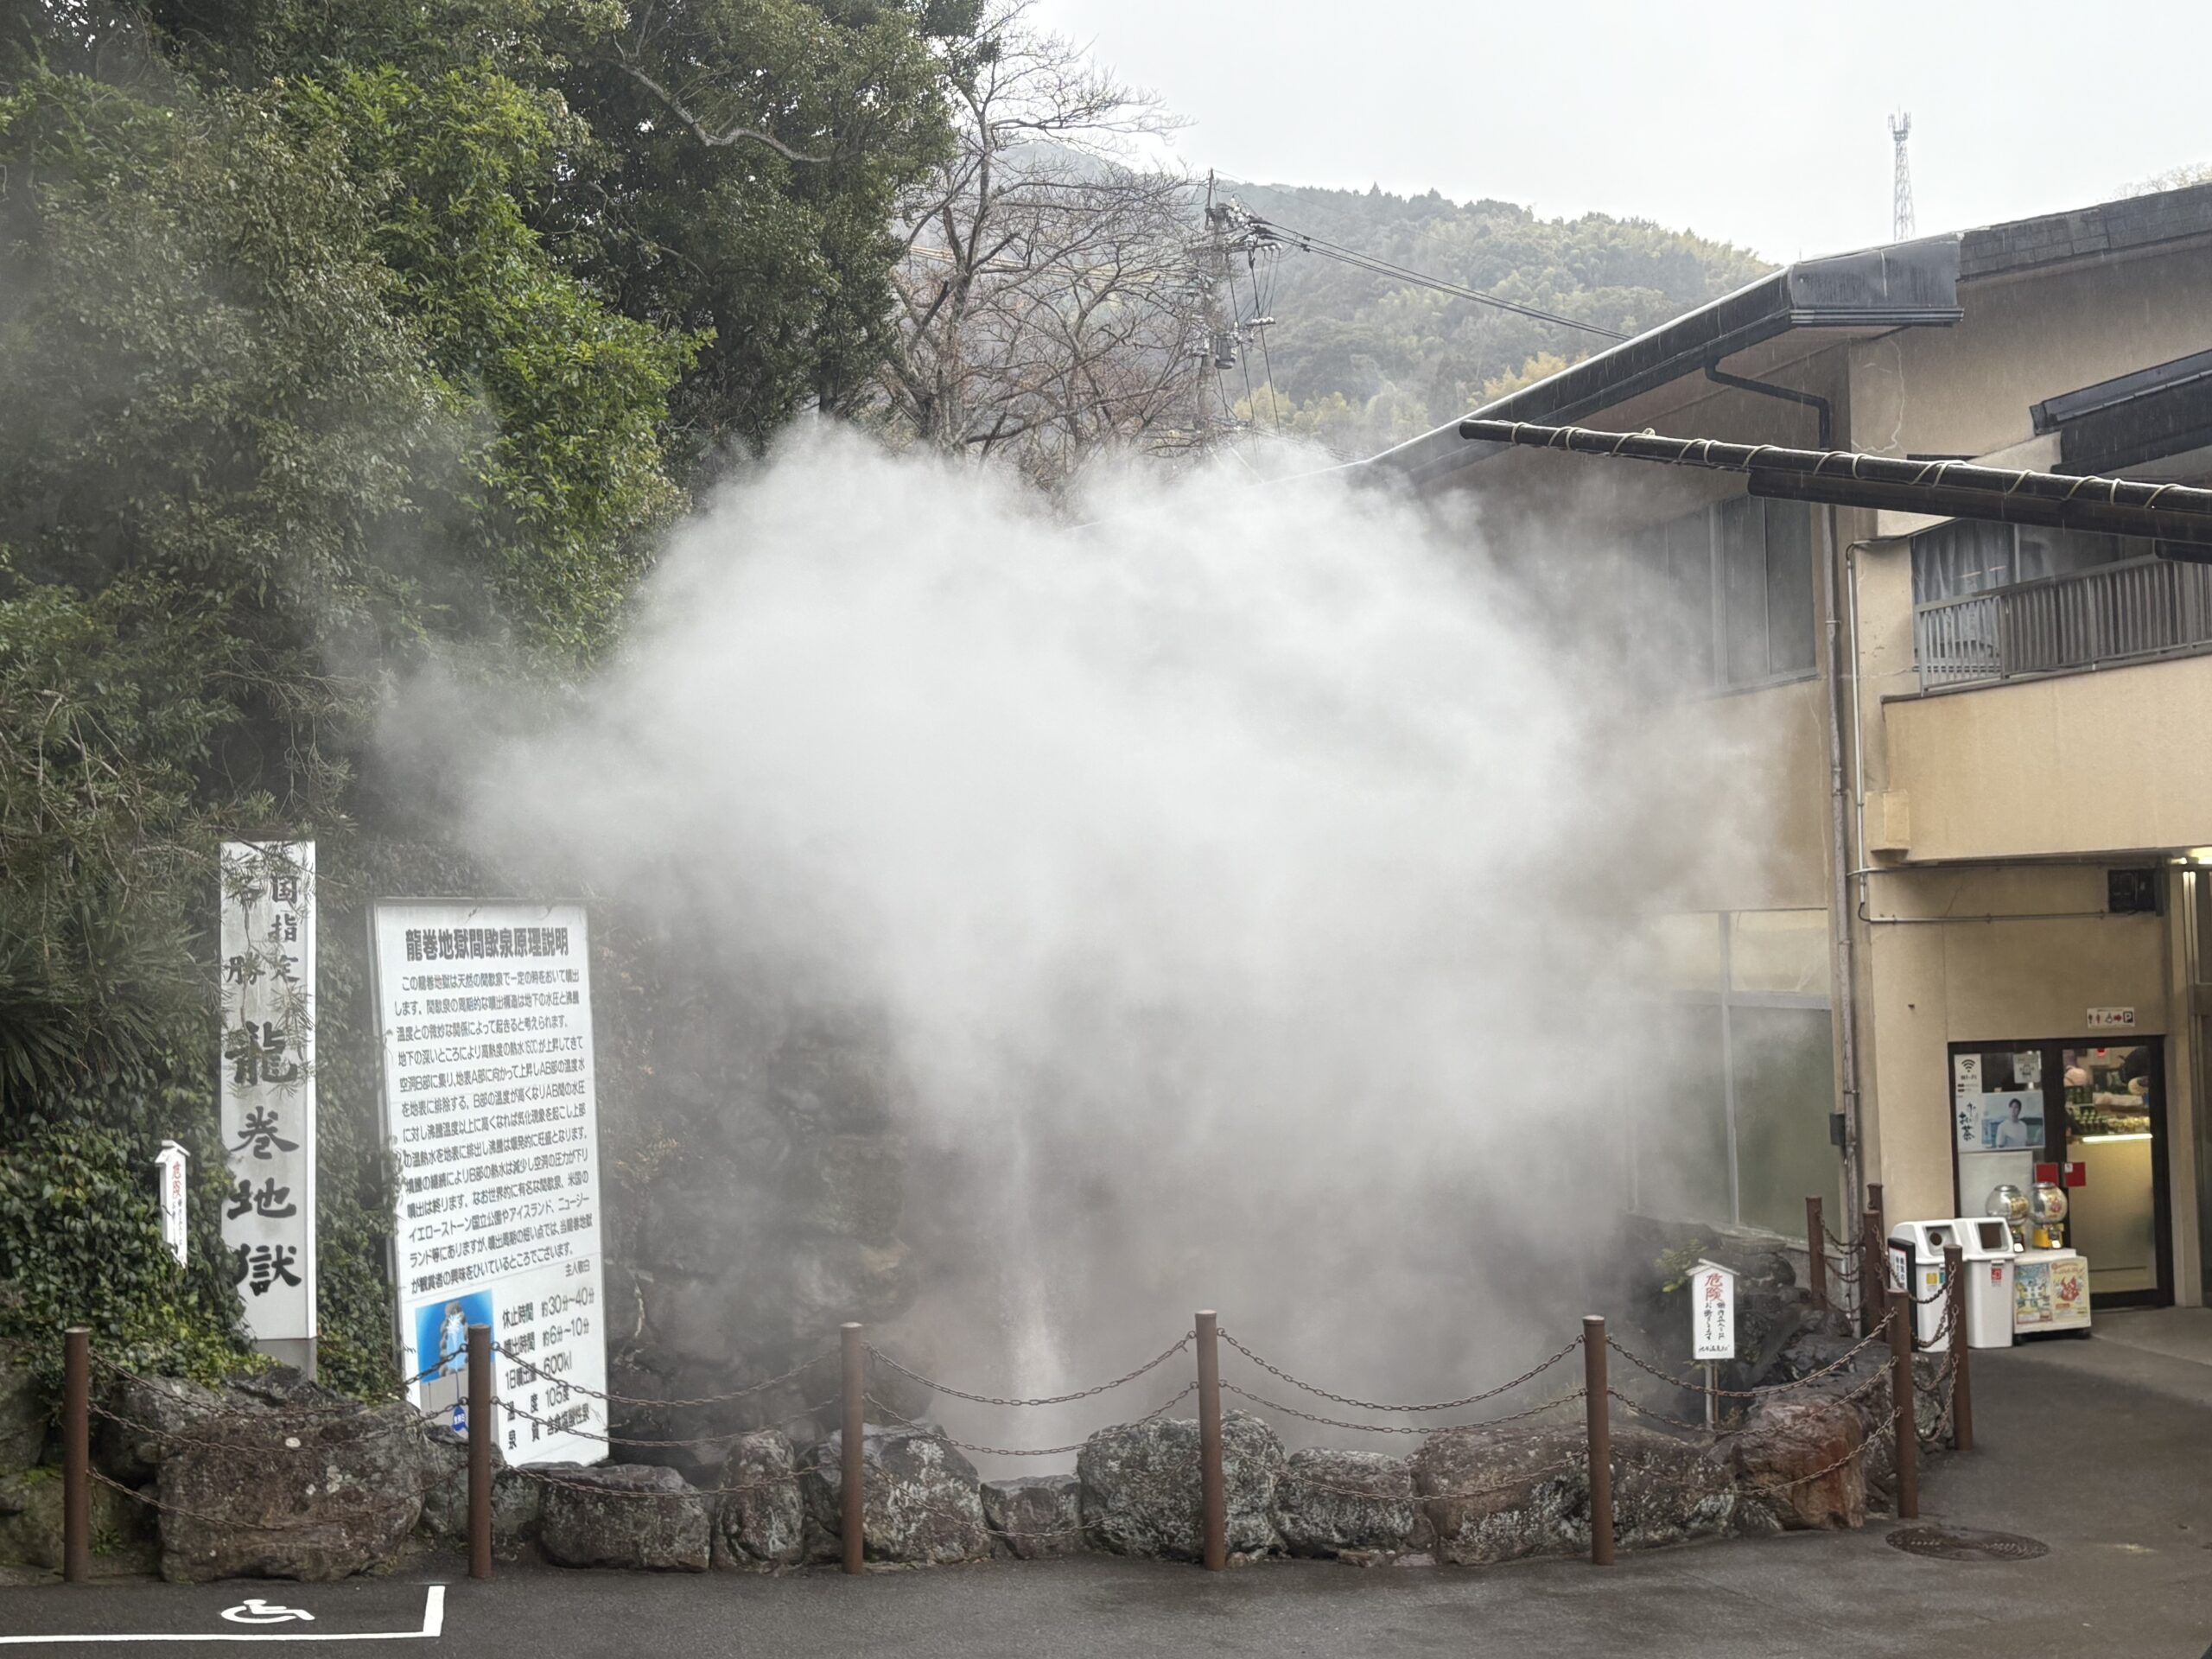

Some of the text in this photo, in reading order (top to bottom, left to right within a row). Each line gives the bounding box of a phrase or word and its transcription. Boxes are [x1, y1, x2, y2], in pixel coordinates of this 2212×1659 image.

[268, 874, 300, 983] 国指定
[225, 1022, 302, 1296] 龍巻地獄
[503, 1301, 534, 1329] 休止時間
[1705, 1273, 1723, 1301] 危険
